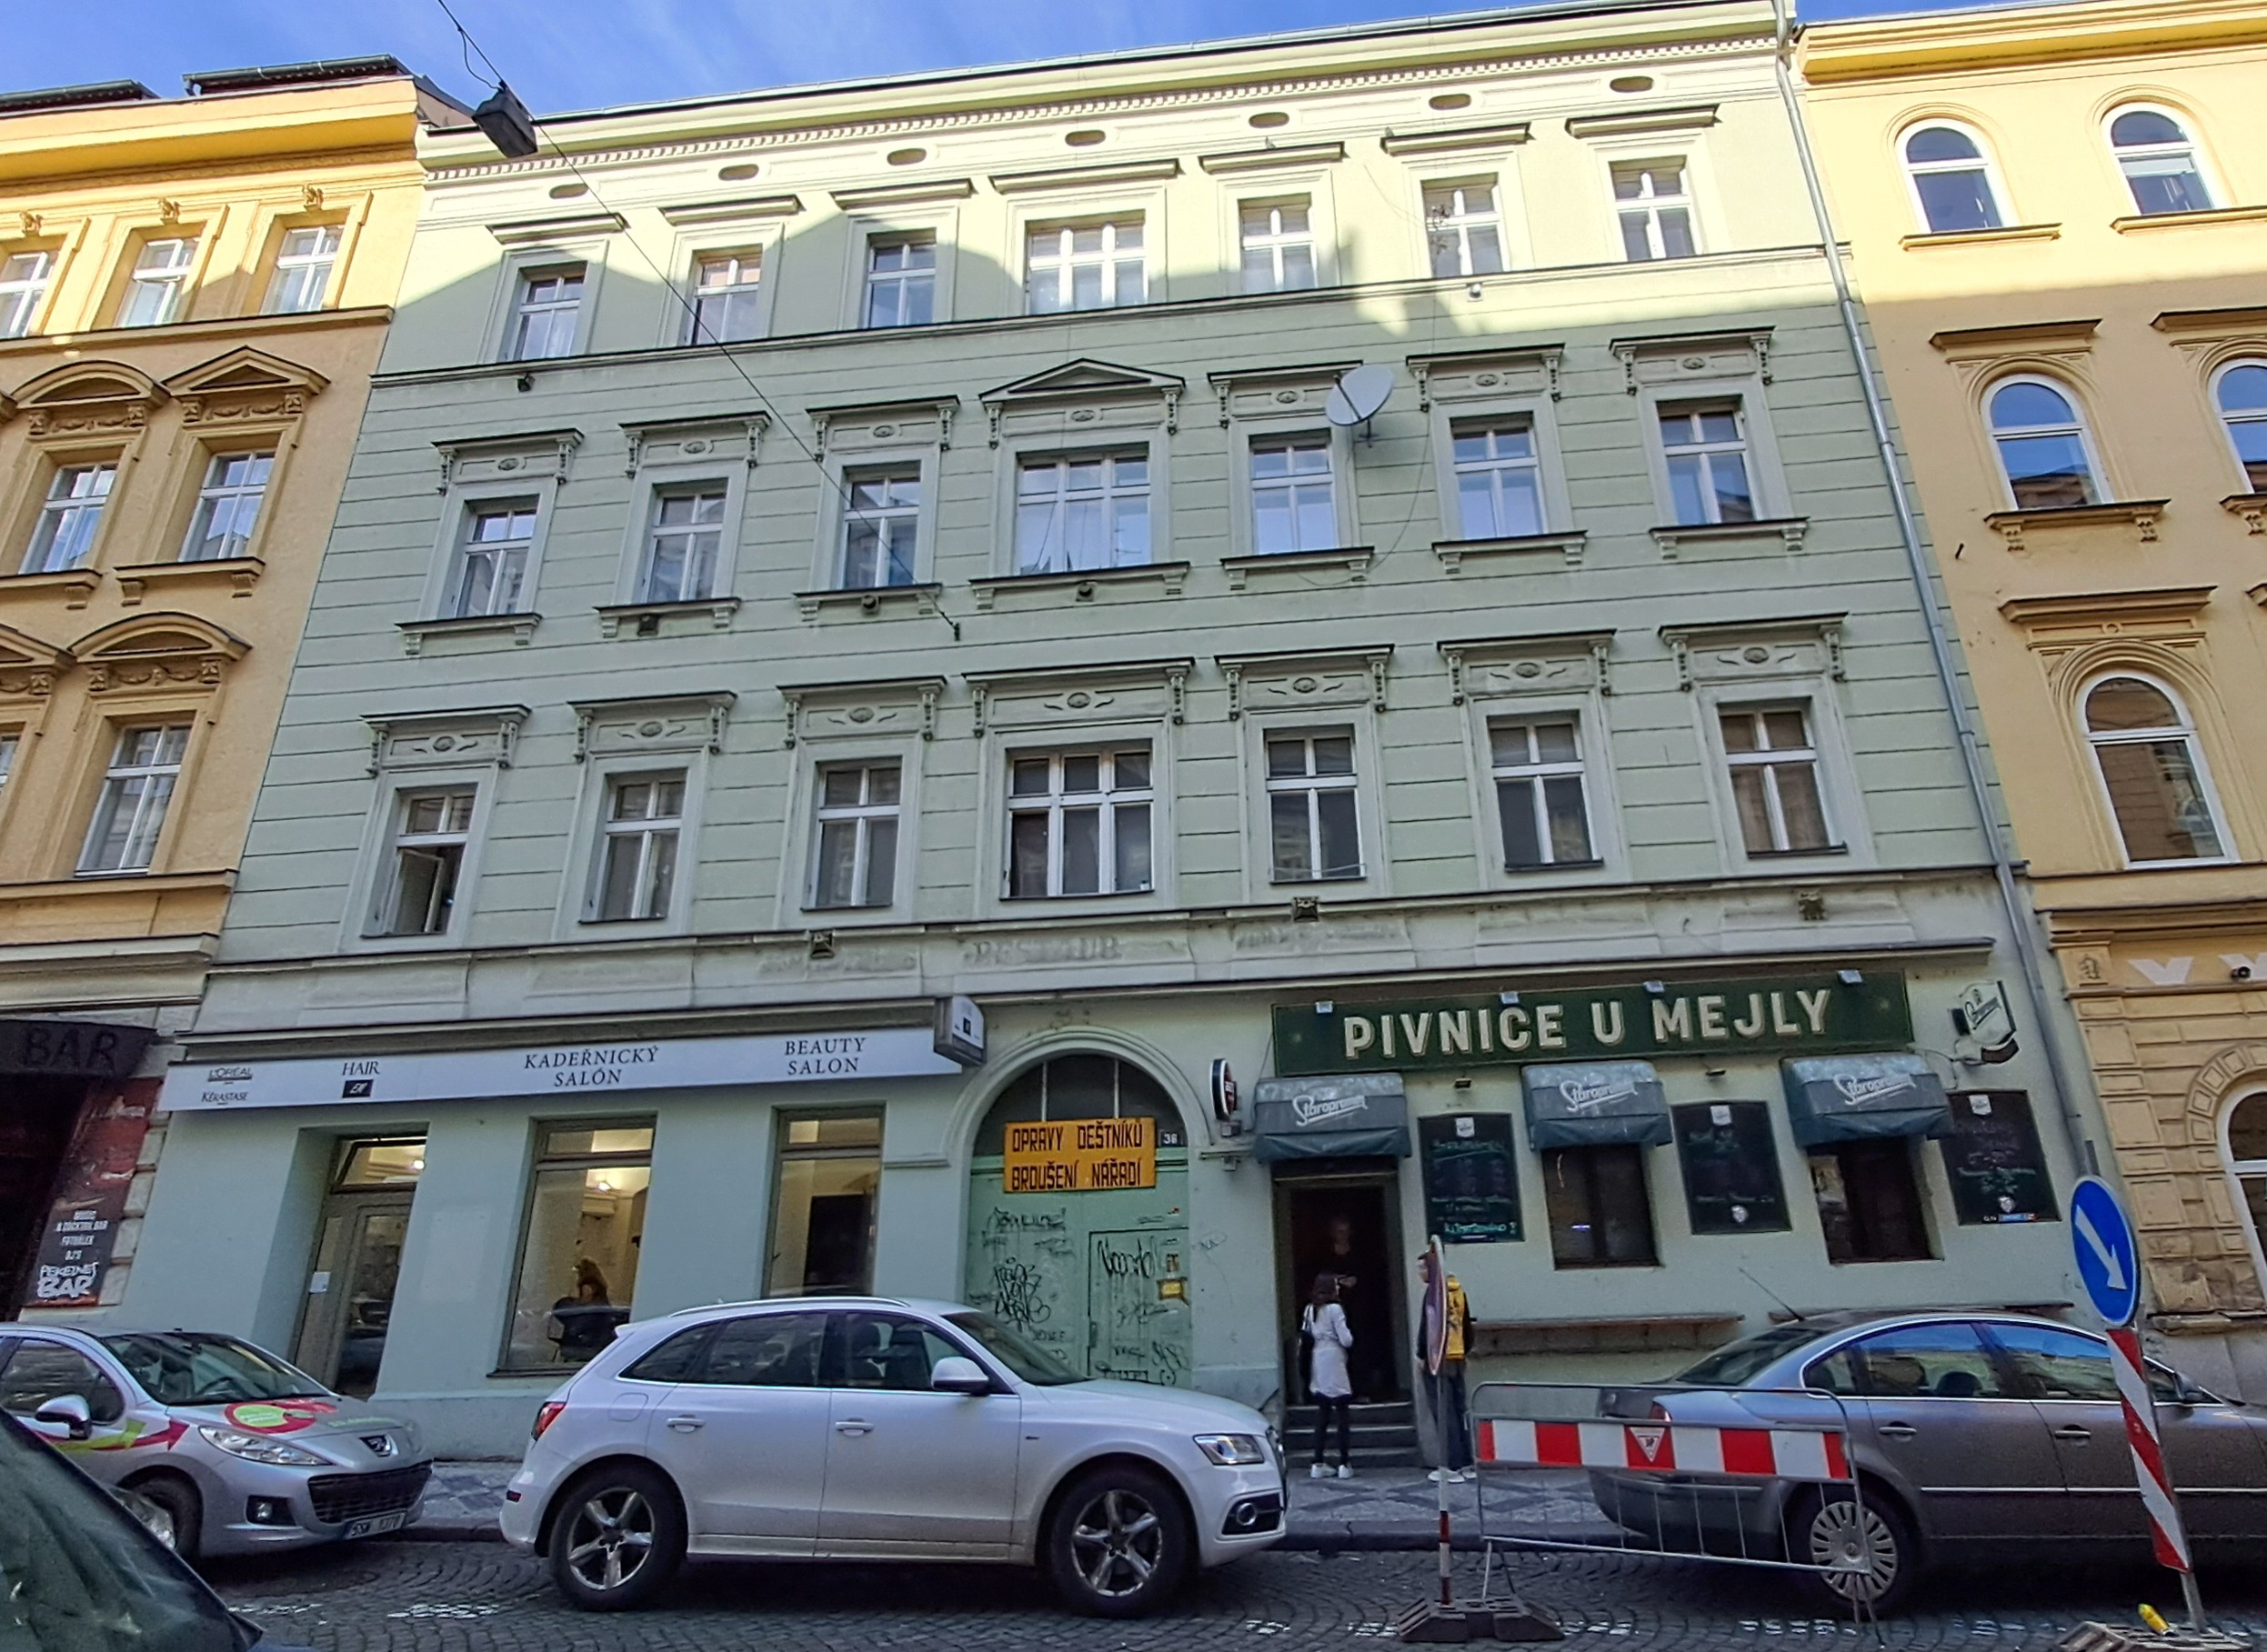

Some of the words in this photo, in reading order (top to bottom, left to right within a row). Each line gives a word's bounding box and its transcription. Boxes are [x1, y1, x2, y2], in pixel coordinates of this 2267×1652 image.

[1343, 1005, 1565, 1059] PIVNICE
[1590, 1000, 1626, 1046] U
[1651, 989, 1831, 1043] MEJLY
[524, 1045, 659, 1069] KADEŘNICKÝ
[785, 1037, 867, 1056] BEAUTY
[342, 1061, 380, 1076] HAIR
[554, 1067, 622, 1087] SALÓN
[787, 1057, 859, 1076] SALON
[1012, 1126, 1064, 1153] OPRAVY
[1077, 1118, 1143, 1150] DEŠTNÍKŮ
[1012, 1158, 1079, 1191] BROUŠENÍ
[1091, 1156, 1142, 1187] NÁŘADÍ
[37, 1275, 95, 1298] BAR
